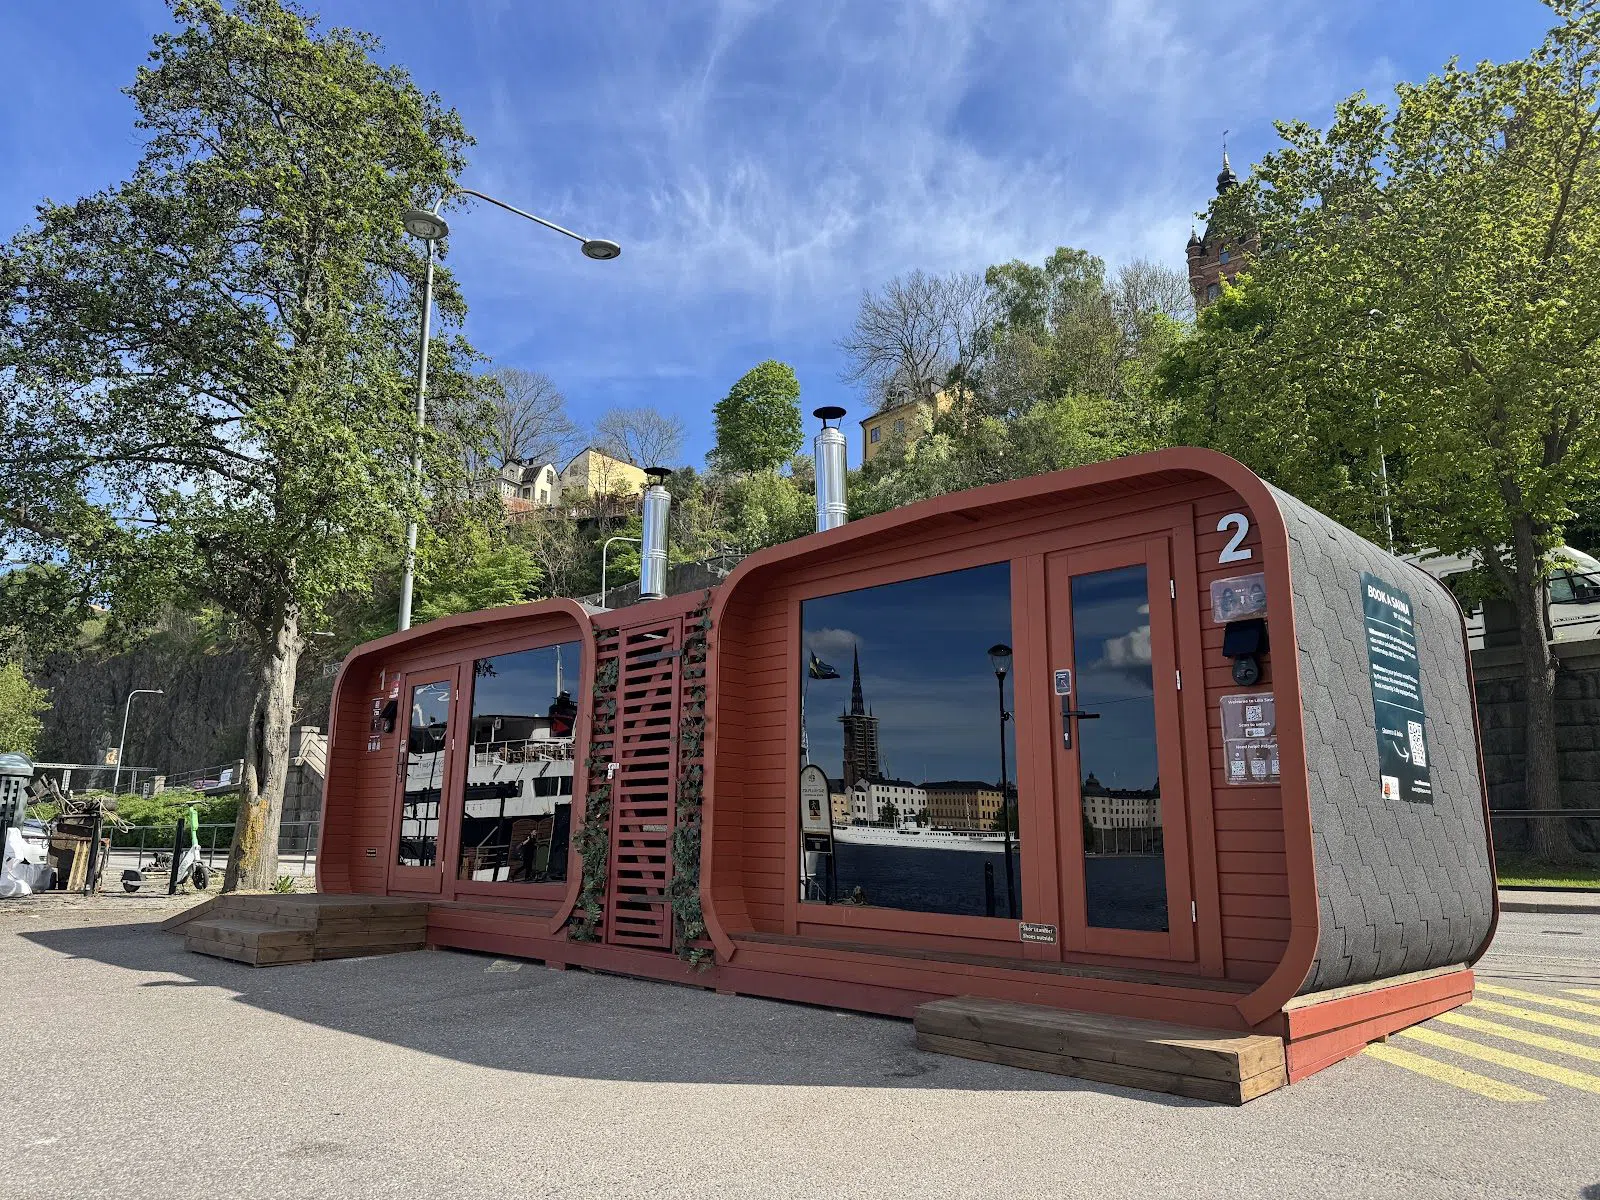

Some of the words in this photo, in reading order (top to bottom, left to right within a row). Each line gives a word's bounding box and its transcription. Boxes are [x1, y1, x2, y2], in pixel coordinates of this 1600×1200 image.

[1216, 512, 1252, 564] 2
[1367, 584, 1387, 603] BOOK
[1386, 594, 1392, 606] A
[379, 667, 386, 691] 1
